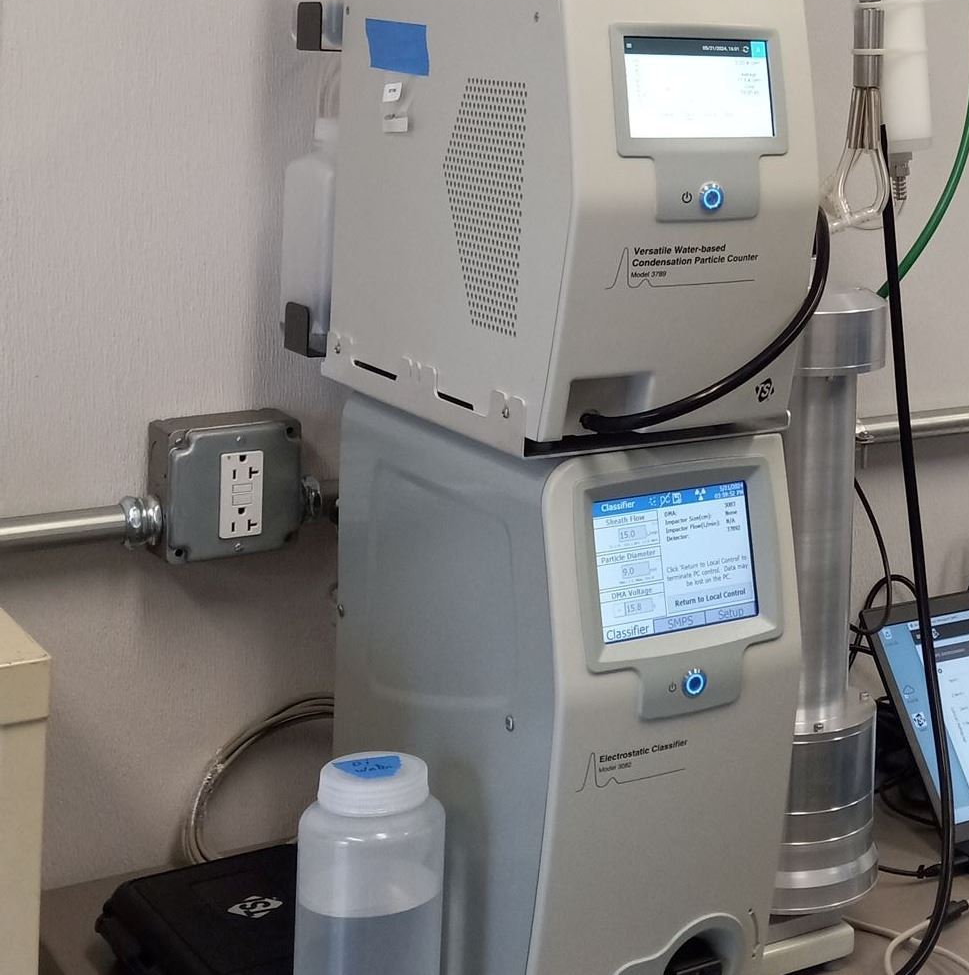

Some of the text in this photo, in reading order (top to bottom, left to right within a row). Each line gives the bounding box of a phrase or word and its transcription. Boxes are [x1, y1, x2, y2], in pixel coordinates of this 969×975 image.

[634, 244, 727, 256] Versatile Water-based
[632, 253, 758, 267] Condensation Particle Counter
[601, 500, 636, 513] Classifier
[606, 517, 629, 526] Sheath
[620, 530, 635, 540] 15.0
[601, 550, 656, 563] Particle Diameter
[694, 578, 704, 586] lost
[611, 588, 652, 600] DMA Voltage
[675, 597, 697, 607] Return
[706, 593, 722, 602] Local
[723, 588, 746, 598] Control
[719, 608, 744, 620] Setup
[668, 615, 694, 629] SMPS
[606, 625, 649, 641] Classifier
[600, 739, 688, 763] Electrostatic Classifier
[599, 765, 617, 773] Model
